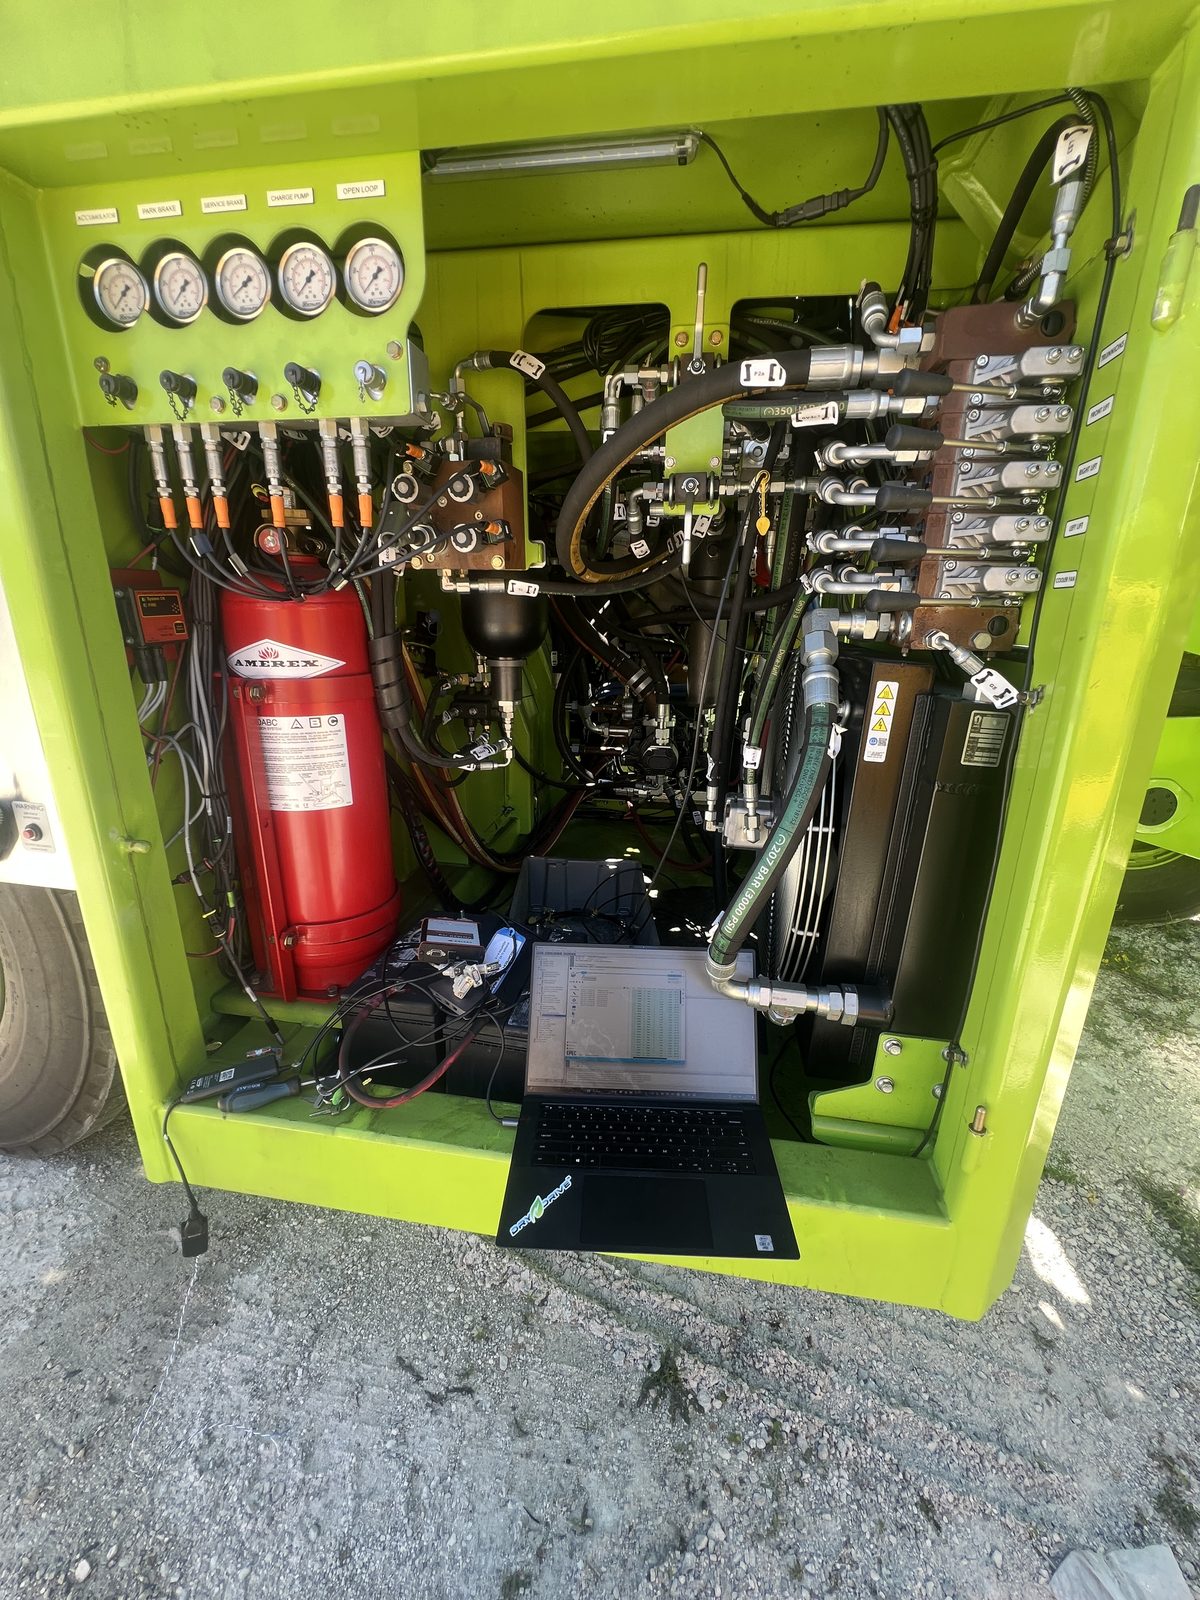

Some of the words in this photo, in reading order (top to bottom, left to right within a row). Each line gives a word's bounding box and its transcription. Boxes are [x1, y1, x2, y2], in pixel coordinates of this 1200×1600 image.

[361, 185, 378, 193] LOOP
[774, 405, 793, 415] 350
[235, 659, 319, 667] AMEREX
[766, 845, 781, 866] 207
[751, 866, 769, 888] BAR
[735, 888, 756, 916] (3000
[724, 915, 738, 934] PSI)
